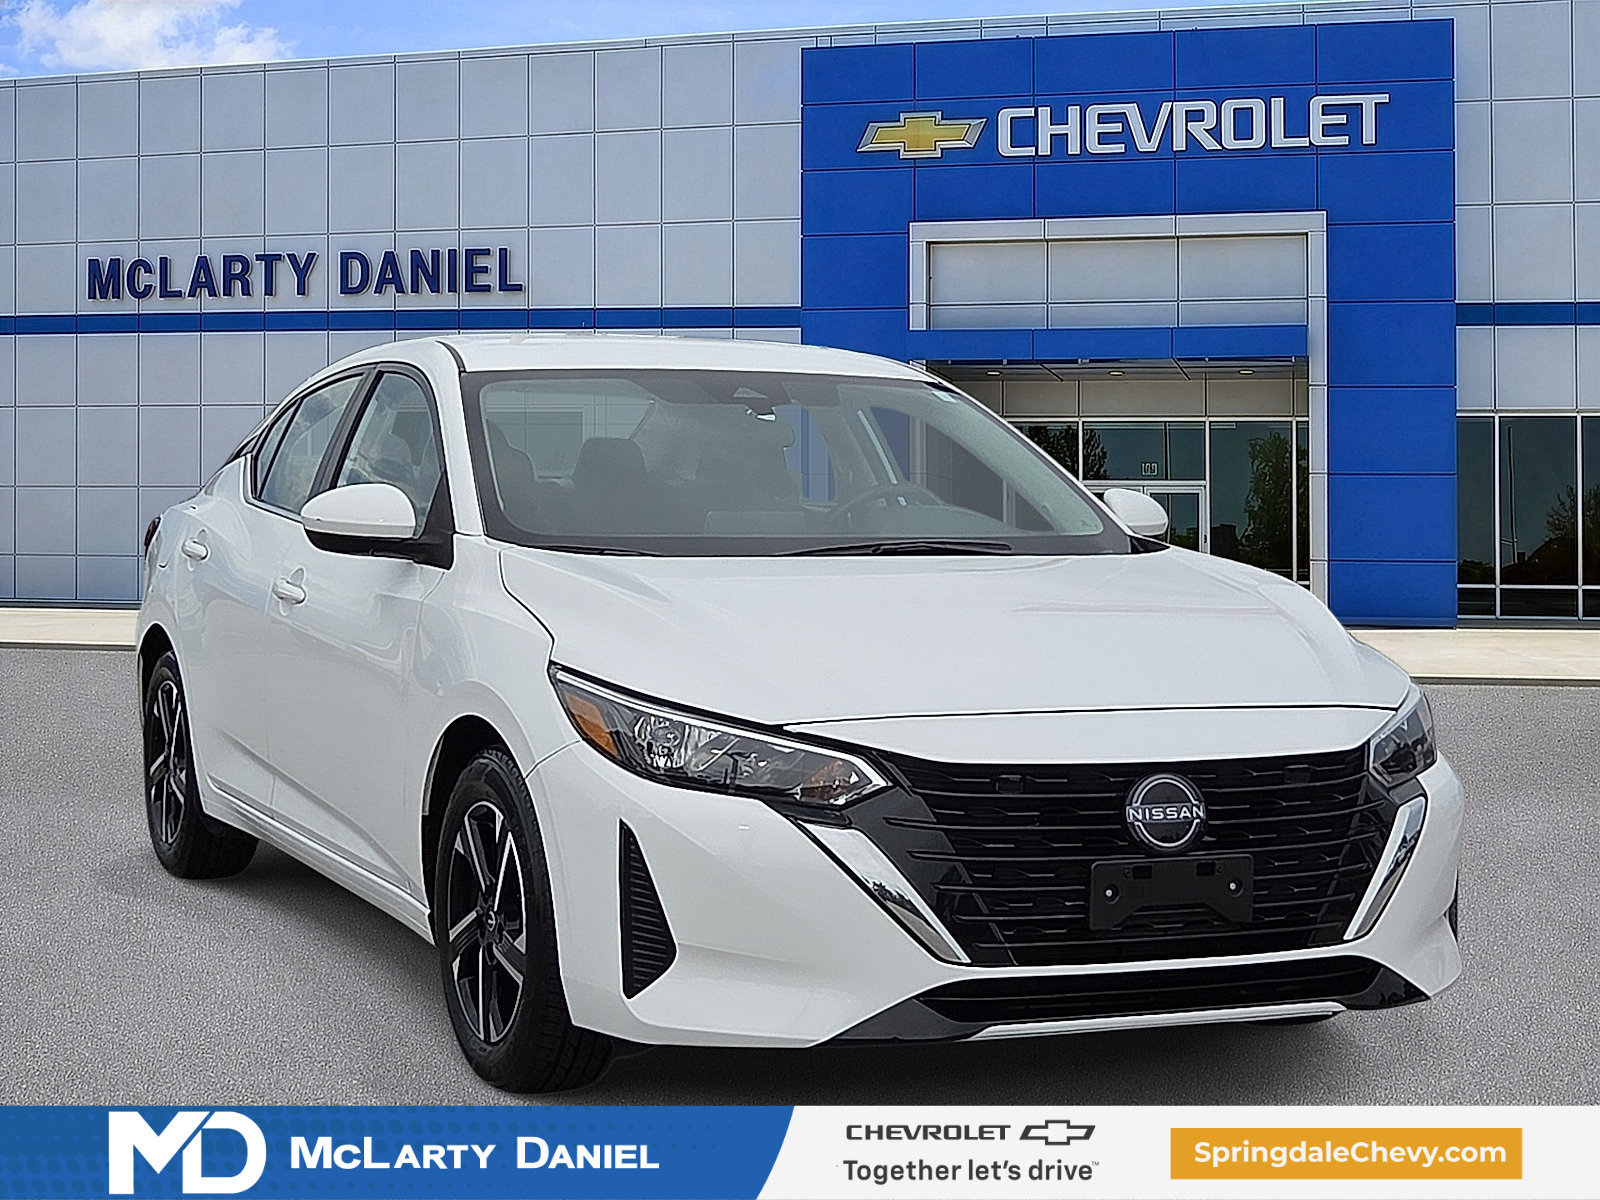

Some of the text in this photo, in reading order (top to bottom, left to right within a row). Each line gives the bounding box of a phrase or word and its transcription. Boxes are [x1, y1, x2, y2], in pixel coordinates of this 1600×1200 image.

[998, 93, 1390, 157] CHEVROLET
[87, 247, 524, 300] MCLARTY DANIEL
[1129, 806, 1204, 821] NISSAN
